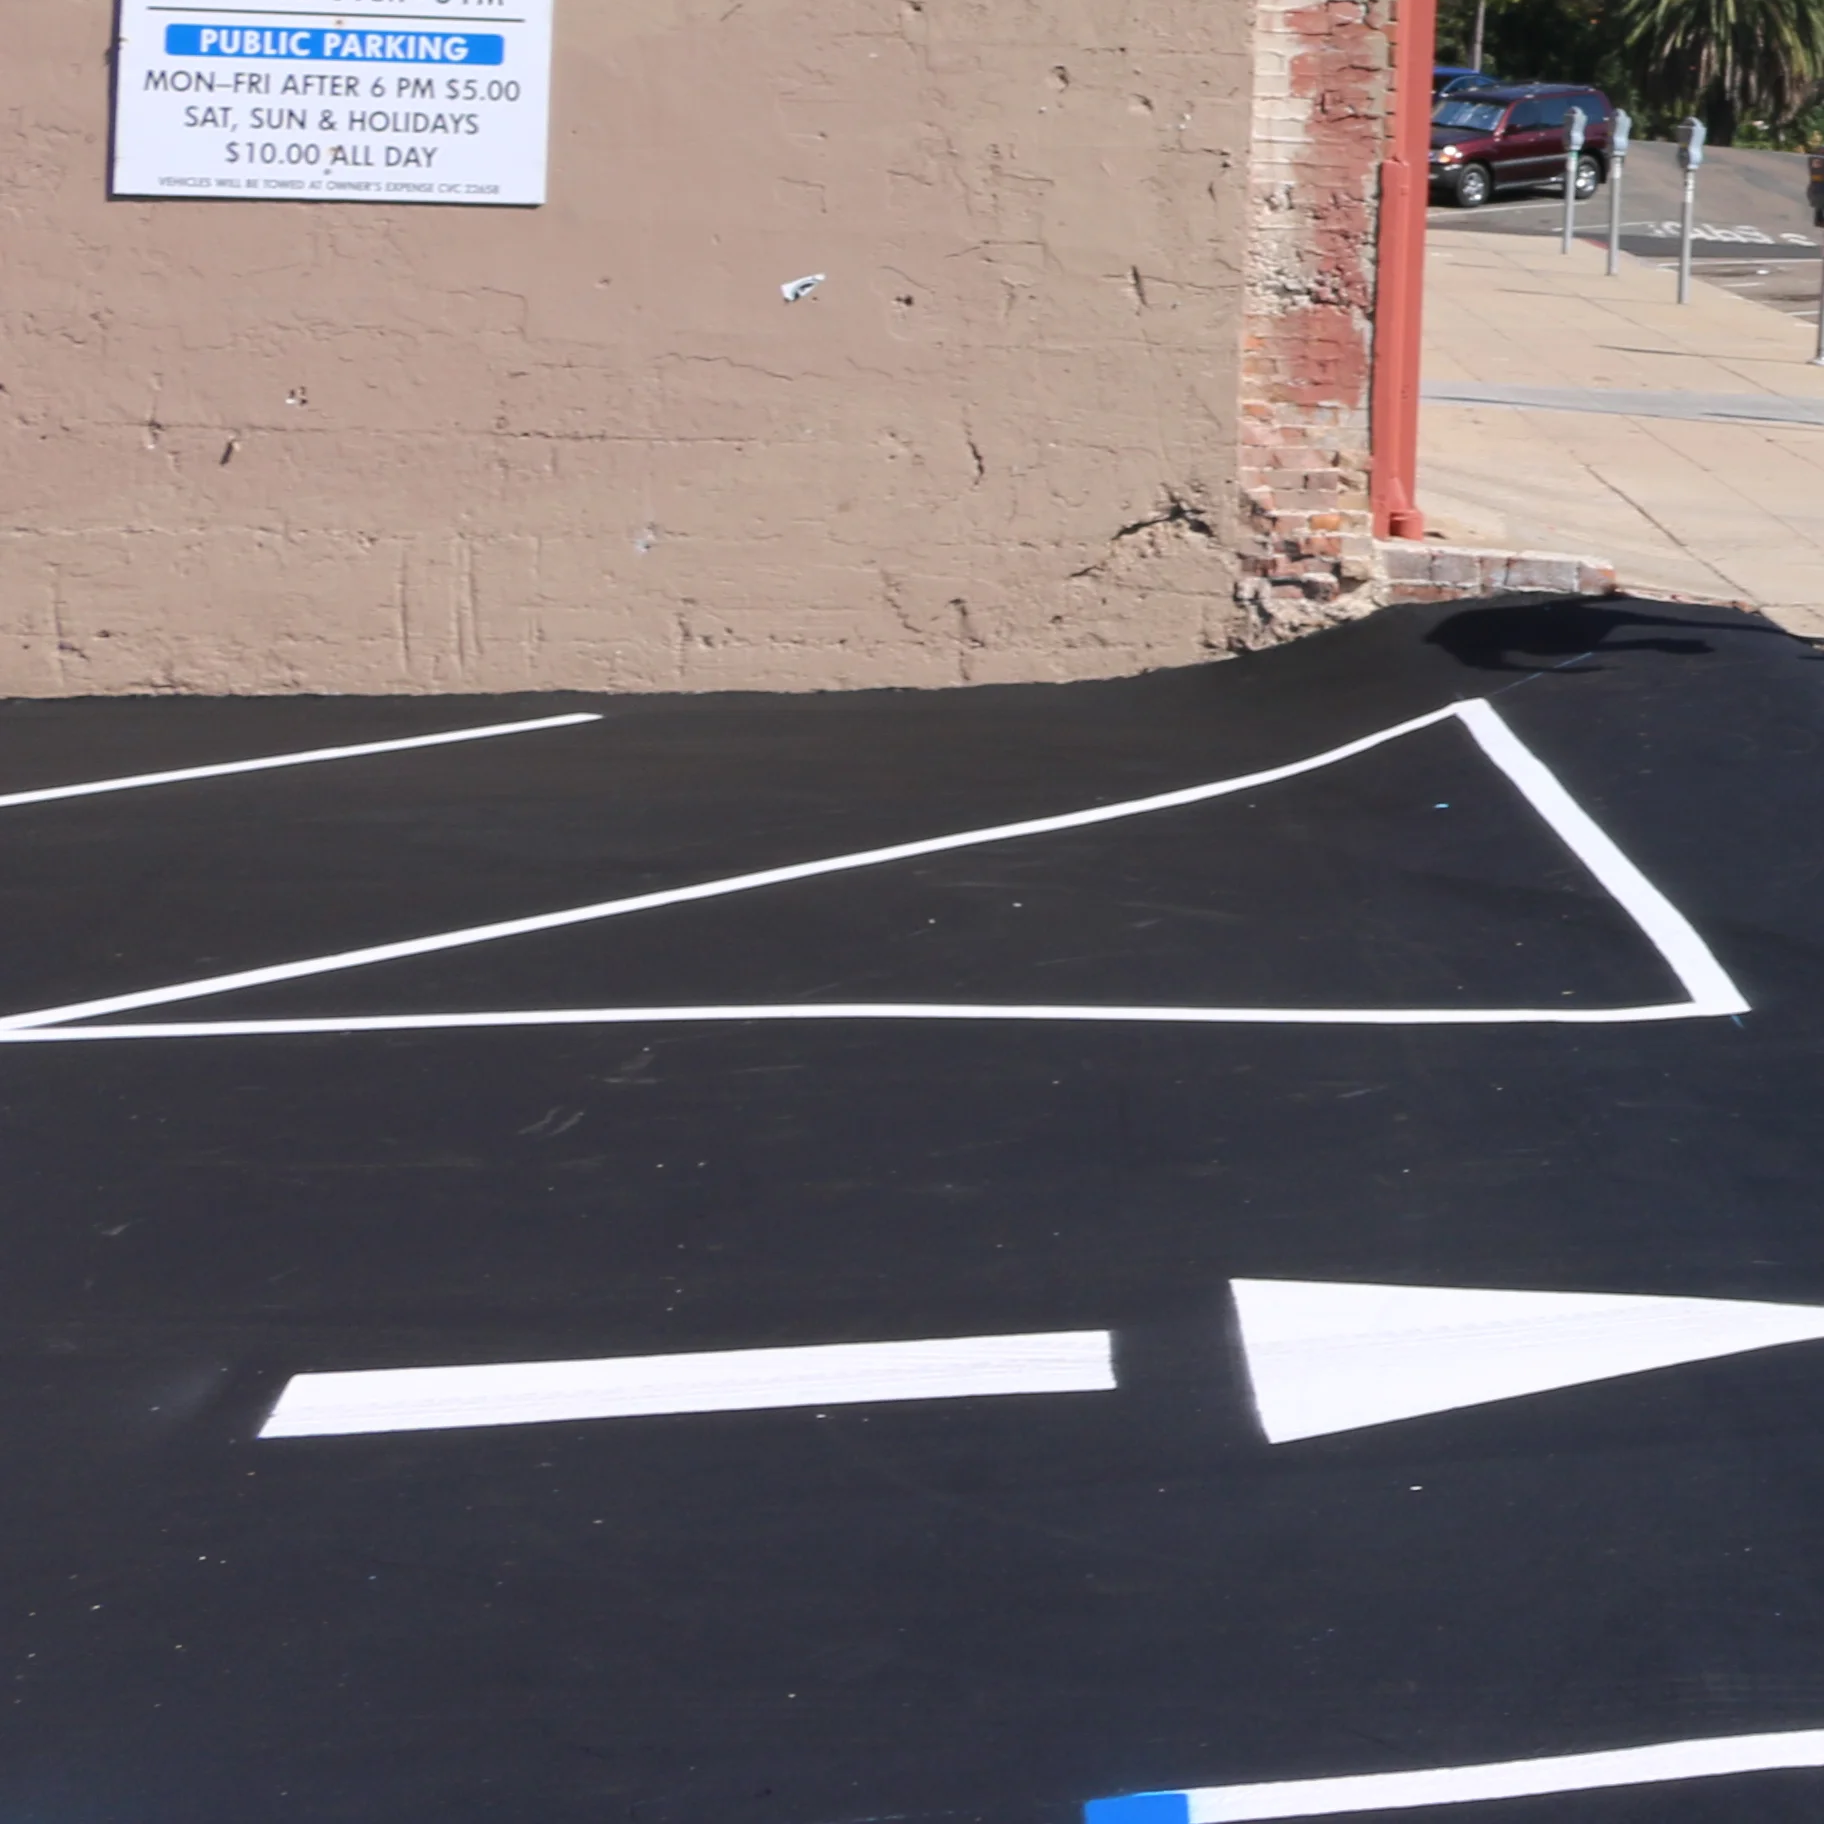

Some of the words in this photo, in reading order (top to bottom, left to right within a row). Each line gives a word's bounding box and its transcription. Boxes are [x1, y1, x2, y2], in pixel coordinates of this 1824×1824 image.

[200, 29, 310, 57] PUBLIC
[323, 33, 469, 60] PARKING
[281, 74, 360, 97] AFTER
[370, 77, 385, 98] 6
[397, 77, 435, 99] PM
[446, 78, 520, 102] $5.00
[185, 105, 237, 132] SAT,
[251, 107, 307, 130] SUN
[318, 109, 336, 131] &
[348, 110, 479, 135] HOLIDAYS
[226, 141, 320, 166] $10.00
[330, 144, 374, 167] ALL
[385, 145, 437, 168] DAY
